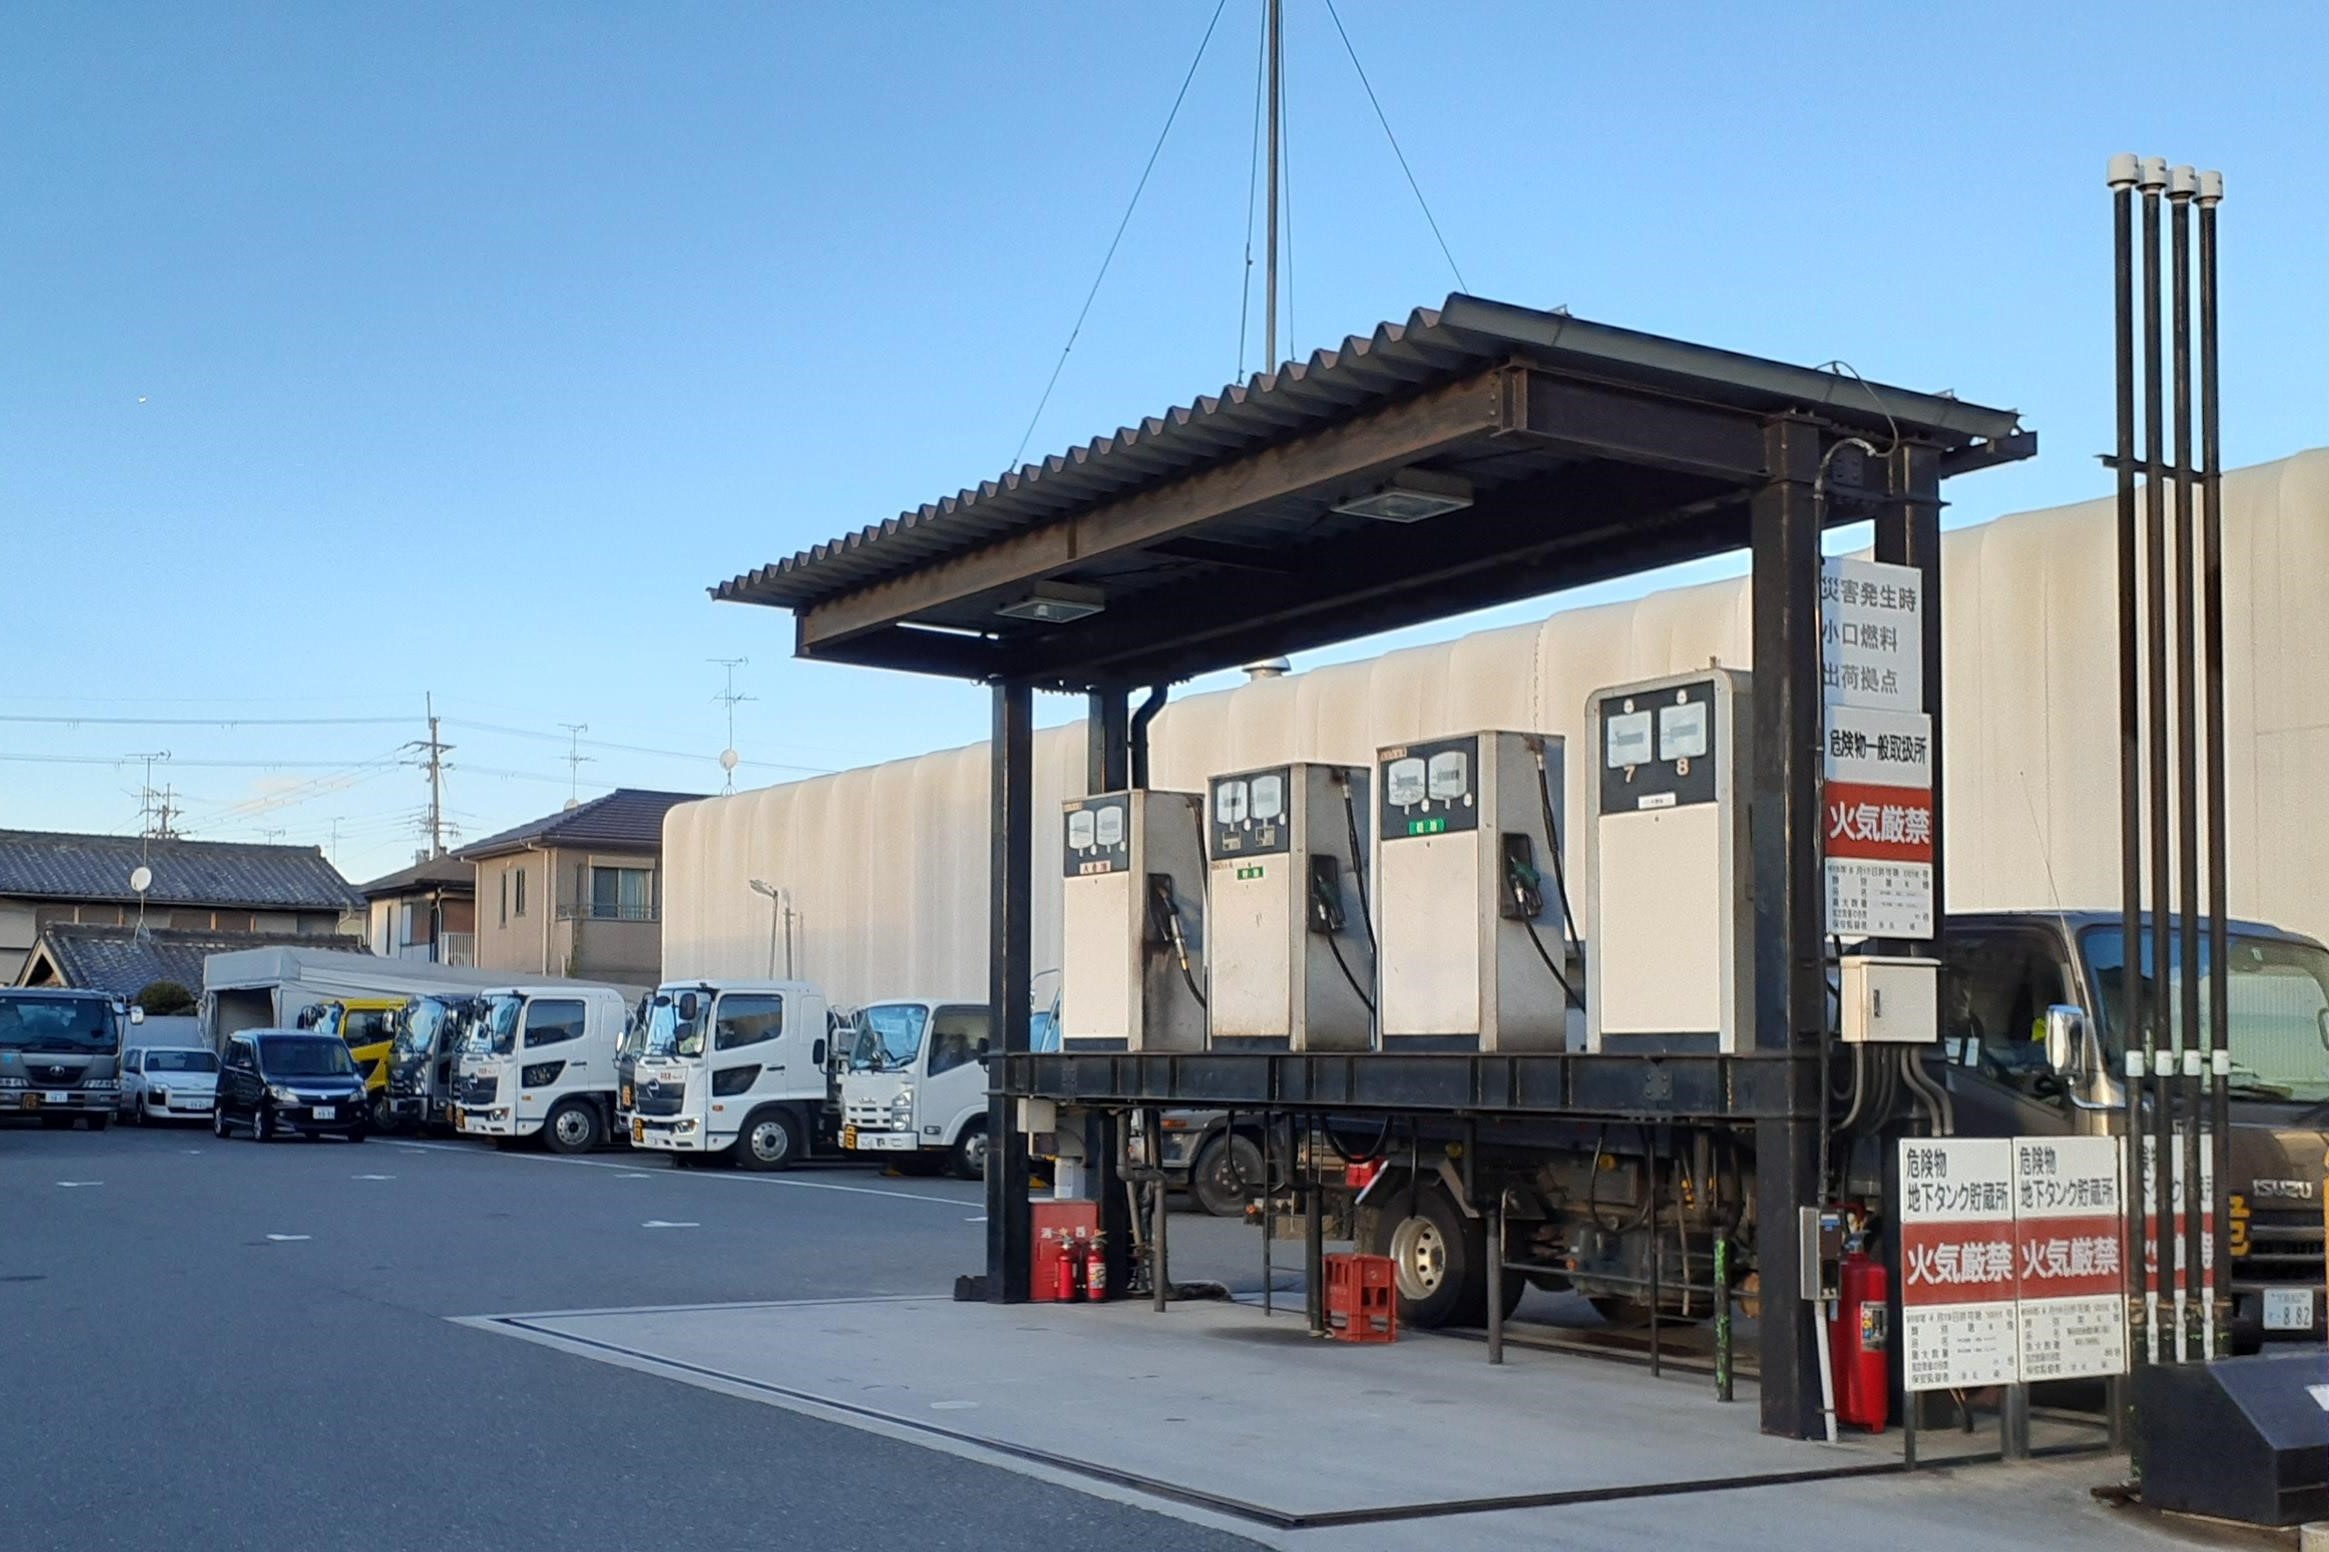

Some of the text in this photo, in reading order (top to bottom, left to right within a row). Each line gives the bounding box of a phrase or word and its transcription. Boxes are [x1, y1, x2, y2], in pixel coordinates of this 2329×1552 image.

[1821, 576, 1916, 612] 災害発生時
[1823, 619, 1897, 652] 小口燃料
[1823, 661, 1898, 694] 出荷拠点
[1830, 729, 1926, 764] 危険物一般取扱所
[1624, 758, 1690, 783] 7 8
[1830, 801, 1930, 844] 火気厳禁
[1907, 1148, 1947, 1178] 危険物
[2020, 1146, 2057, 1175] 危険物
[1908, 1182, 2008, 1212] 地下タンク貯蔵所
[2021, 1177, 2113, 1208] 地下タンク貯蔵所
[2253, 1179, 2313, 1198] ISUZU
[1907, 1242, 2013, 1285] 火気厳禁
[2022, 1236, 2119, 1279] 火気厳禁
